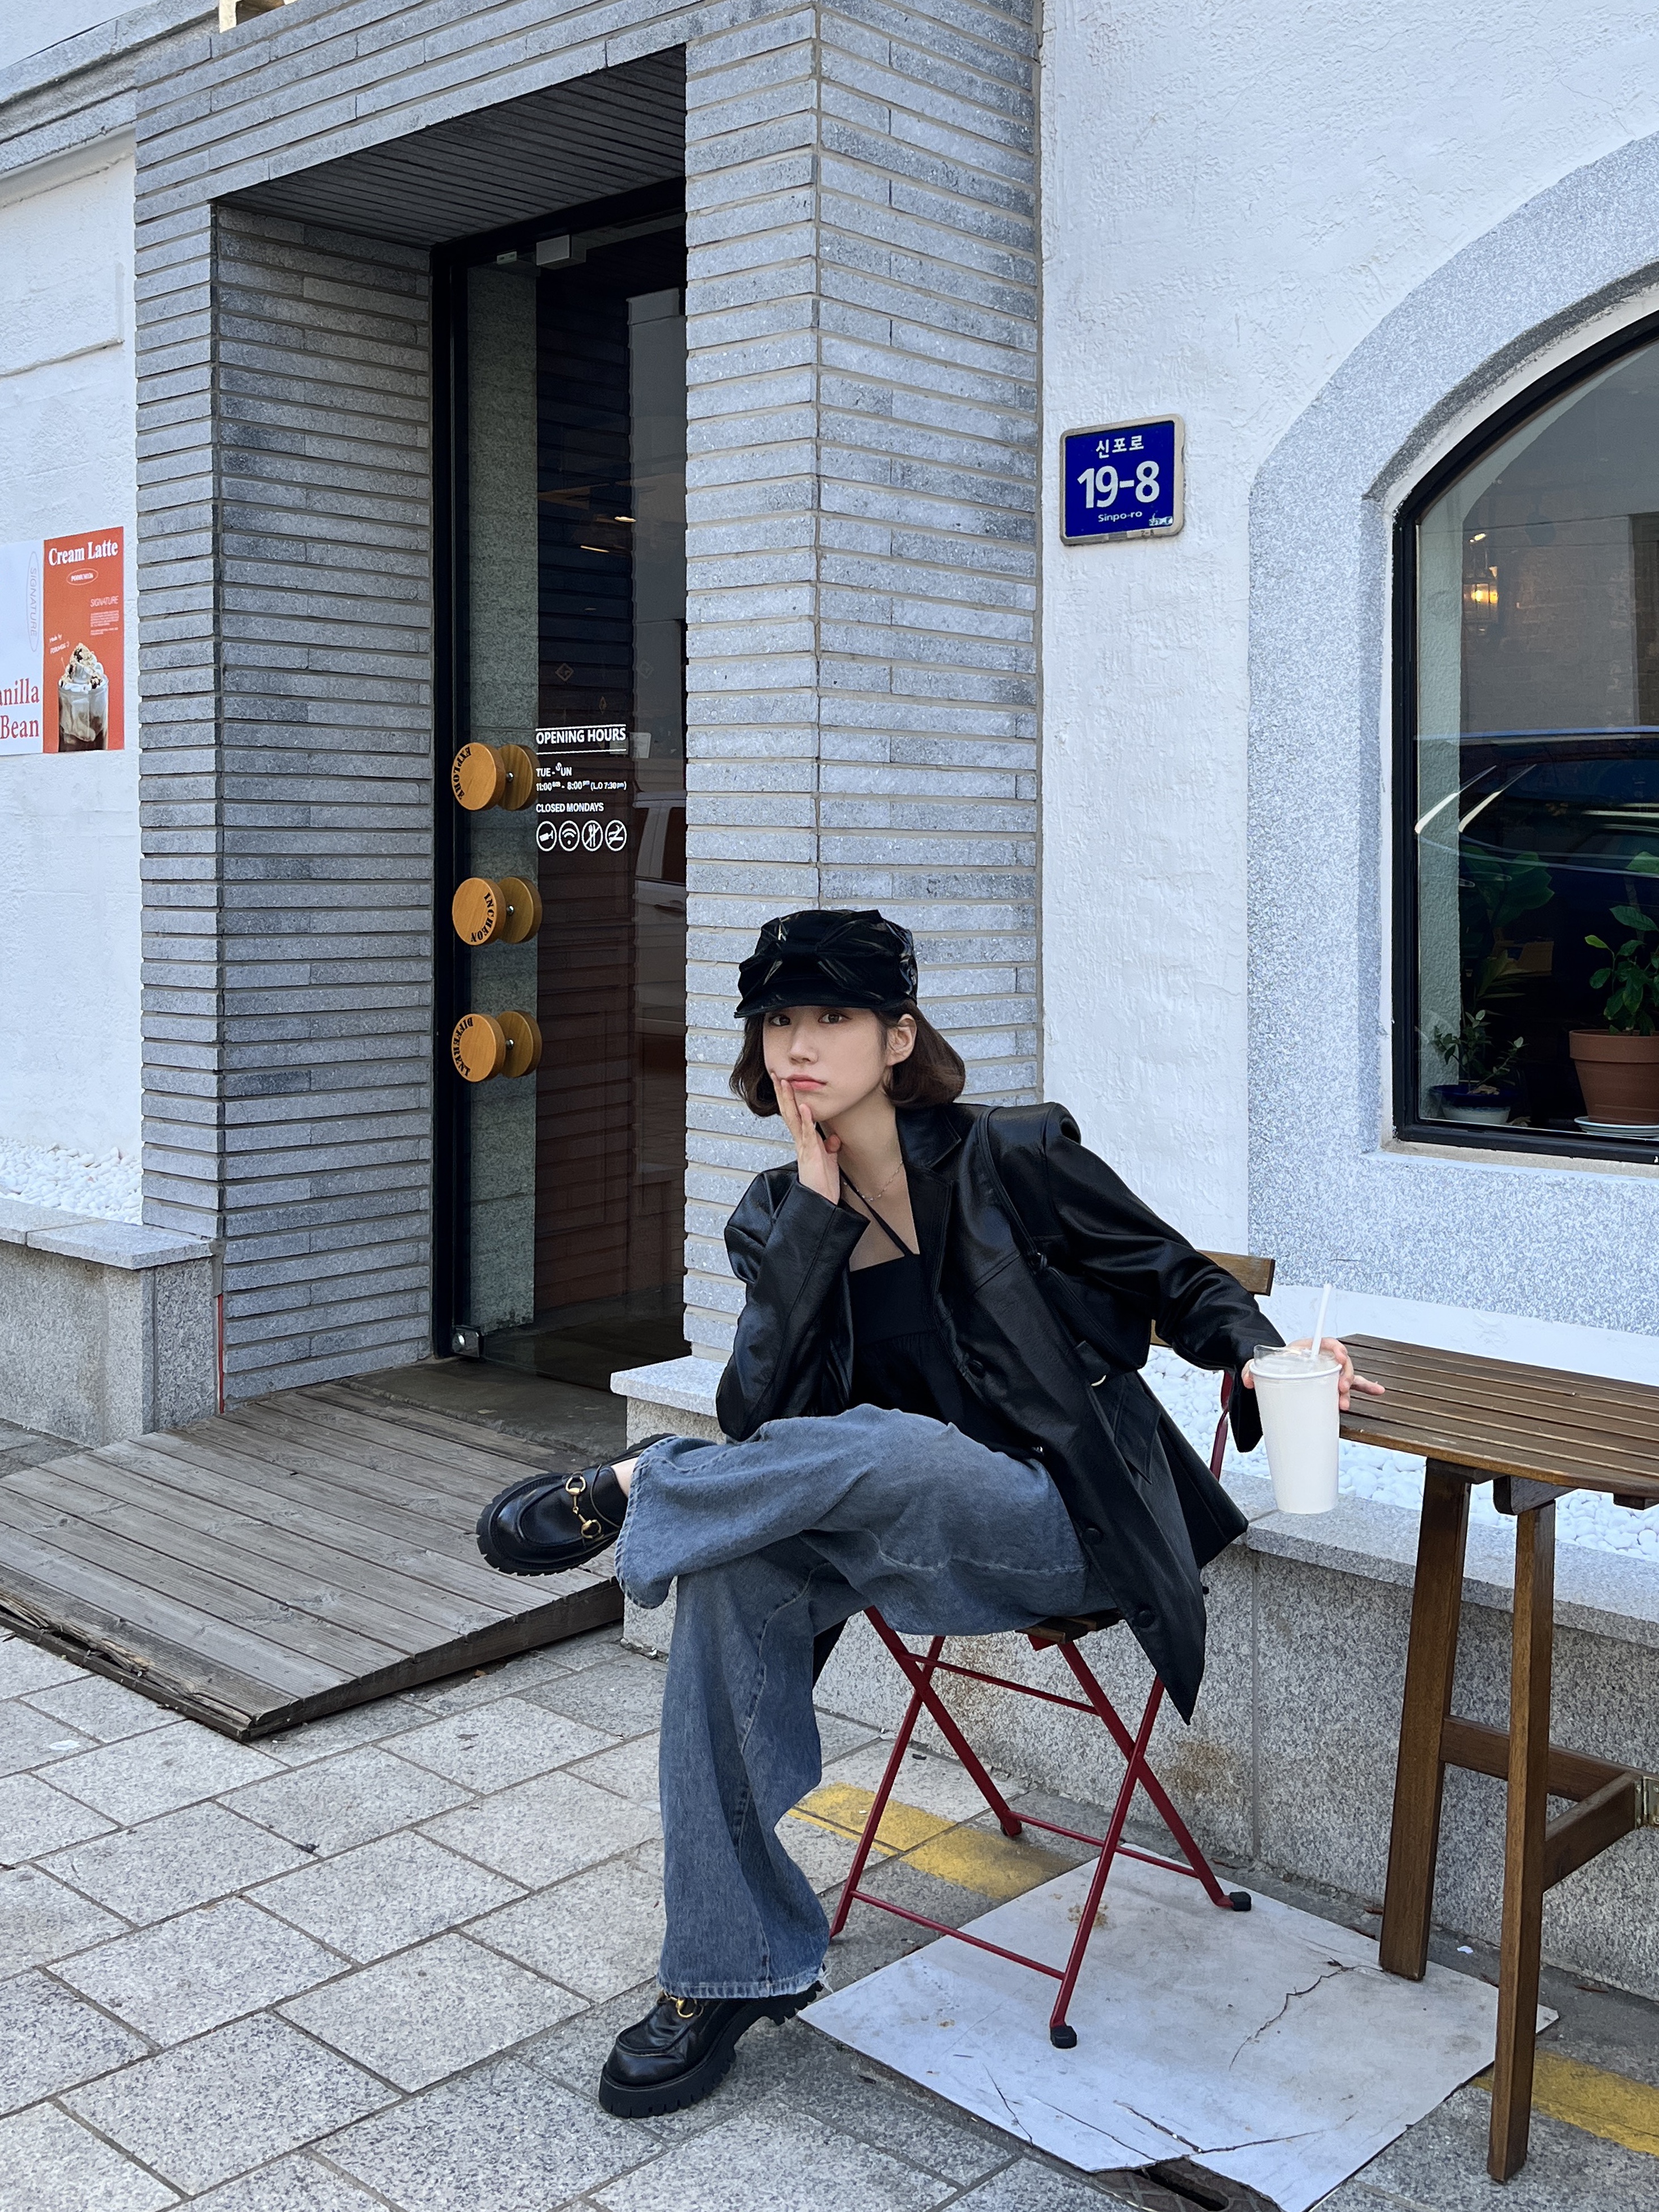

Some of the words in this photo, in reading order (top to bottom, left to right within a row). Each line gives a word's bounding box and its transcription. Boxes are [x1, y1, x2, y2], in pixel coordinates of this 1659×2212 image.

[1096, 435, 1144, 458] 신포로
[1077, 460, 1160, 508] 19-8
[1098, 511, 1143, 523] Sinpo-ro
[49, 547, 85, 566] Cream
[87, 540, 118, 559] Latte
[90, 595, 119, 607] SIGNATURE
[0, 678, 40, 706] nilla
[0, 715, 39, 739] Bean
[536, 730, 584, 744] OPENING
[588, 728, 626, 742] HOURS
[453, 746, 471, 800] EXPLORE
[536, 803, 565, 813] CLOSED
[567, 803, 604, 812] MONDAYS
[471, 893, 494, 942] INCHEON
[453, 1017, 473, 1077] DIFFERENT
